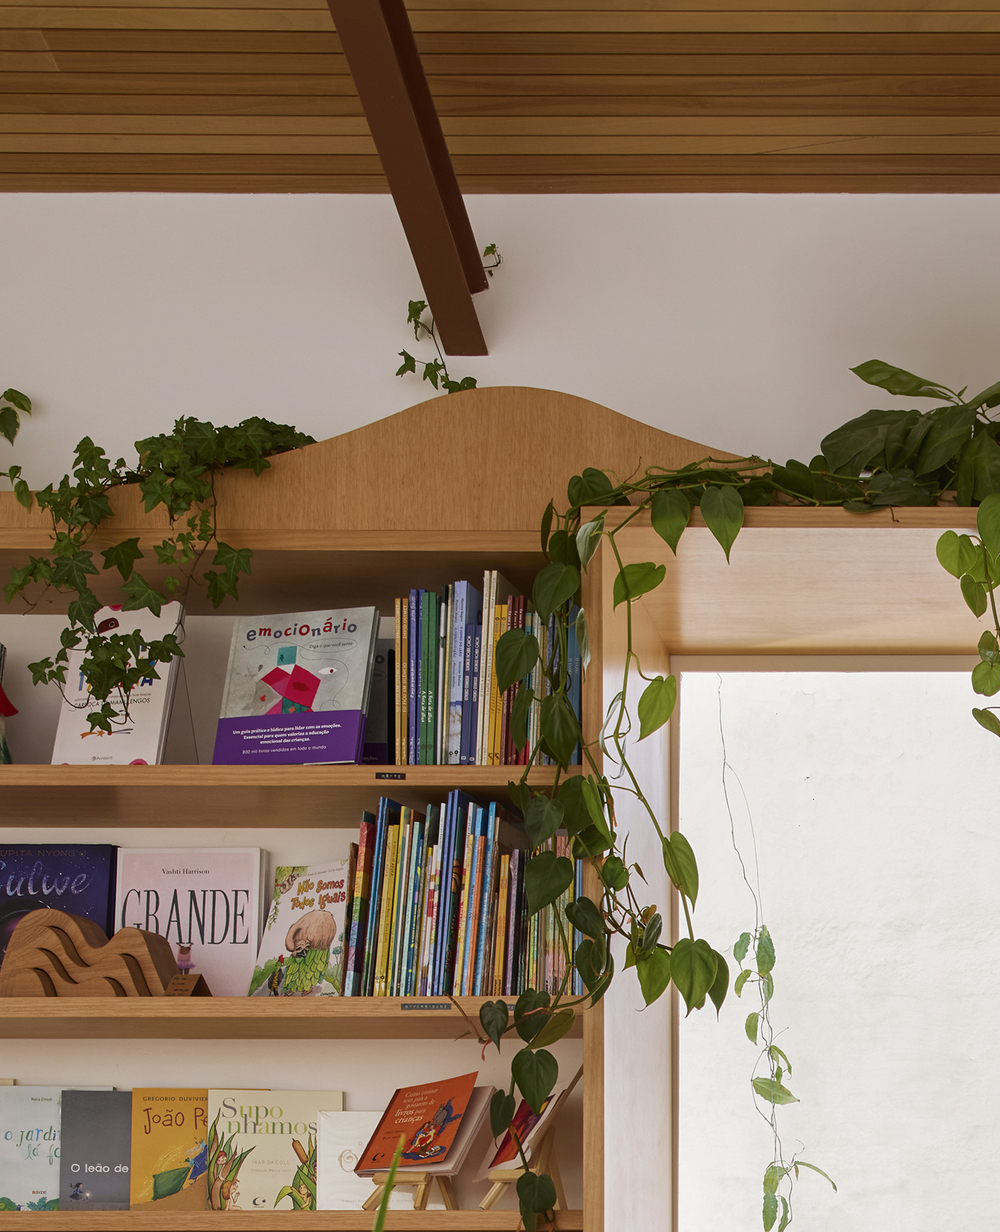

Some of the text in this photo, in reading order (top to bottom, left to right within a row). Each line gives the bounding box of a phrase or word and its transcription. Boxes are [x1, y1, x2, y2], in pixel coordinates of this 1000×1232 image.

[246, 617, 357, 642] emocionário
[297, 879, 344, 896] Não Somos
[291, 891, 346, 910] Todos Iguais
[122, 888, 249, 945] GRANDE
[143, 1107, 184, 1134] João
[222, 1097, 283, 1125] Supo
[395, 1109, 414, 1117] livros
[226, 1114, 317, 1135] nhamos
[4, 1130, 13, 1140] o
[25, 1144, 40, 1160] lá
[71, 1163, 129, 1173] O leão de
